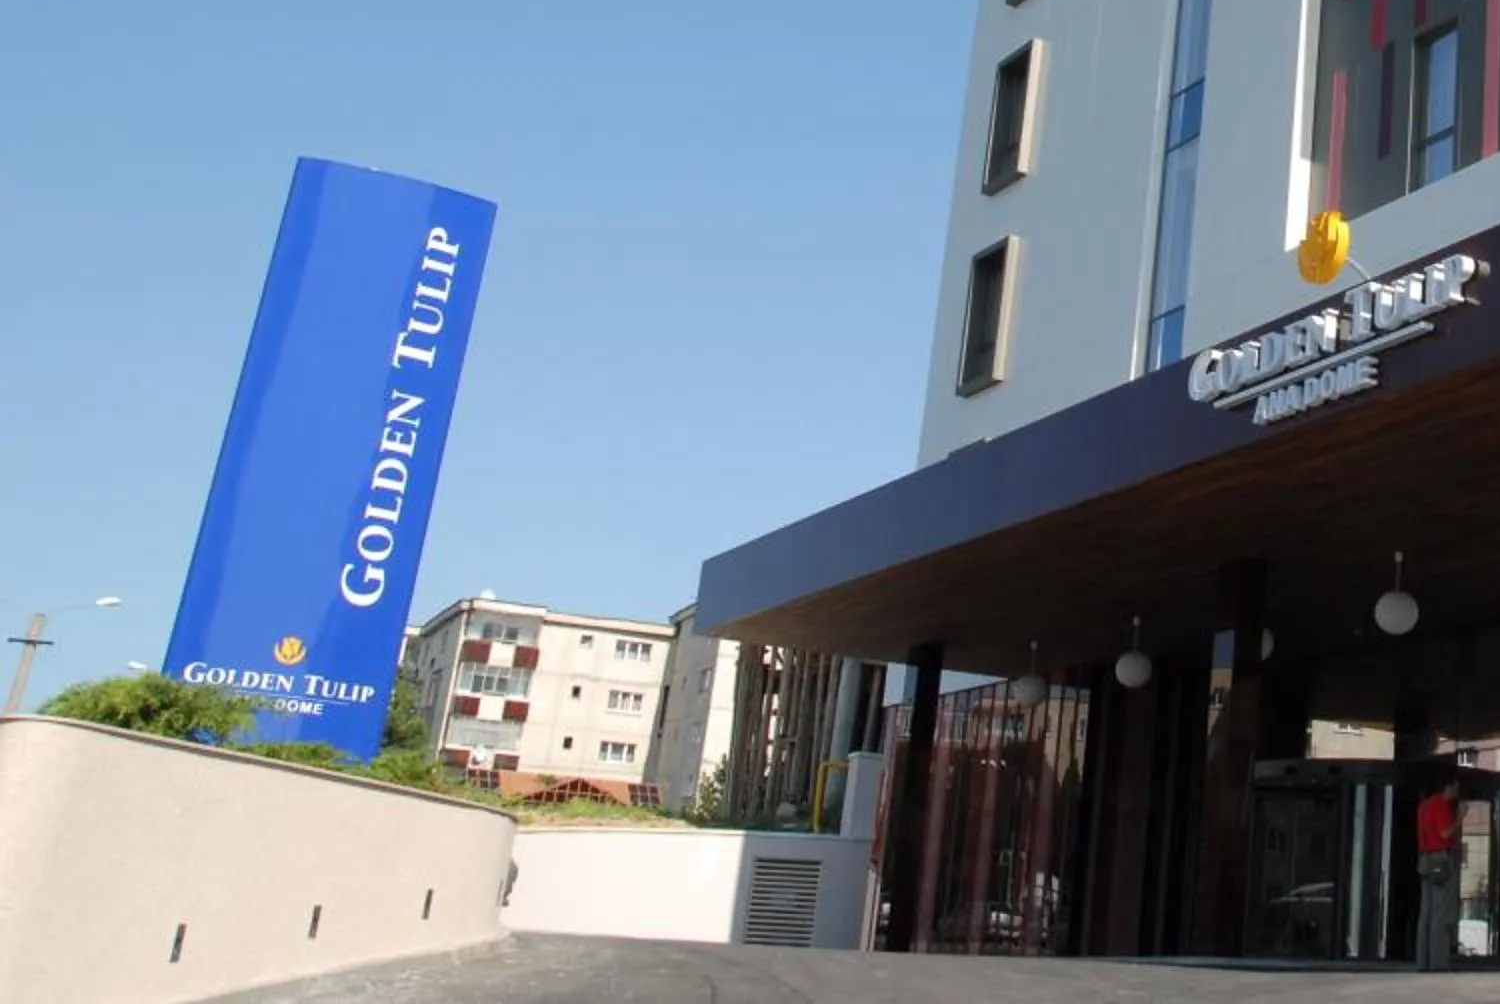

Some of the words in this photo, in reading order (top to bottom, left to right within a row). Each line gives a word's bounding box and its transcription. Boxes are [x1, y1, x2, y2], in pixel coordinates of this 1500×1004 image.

[1188, 307, 1340, 401] GOLDEN
[1344, 254, 1476, 338] TULIP
[340, 390, 426, 608] GOLDEN
[392, 227, 461, 369] TULIP
[1303, 355, 1379, 408] DOME
[183, 661, 296, 693] GOLDEN
[303, 673, 376, 704] TULIP
